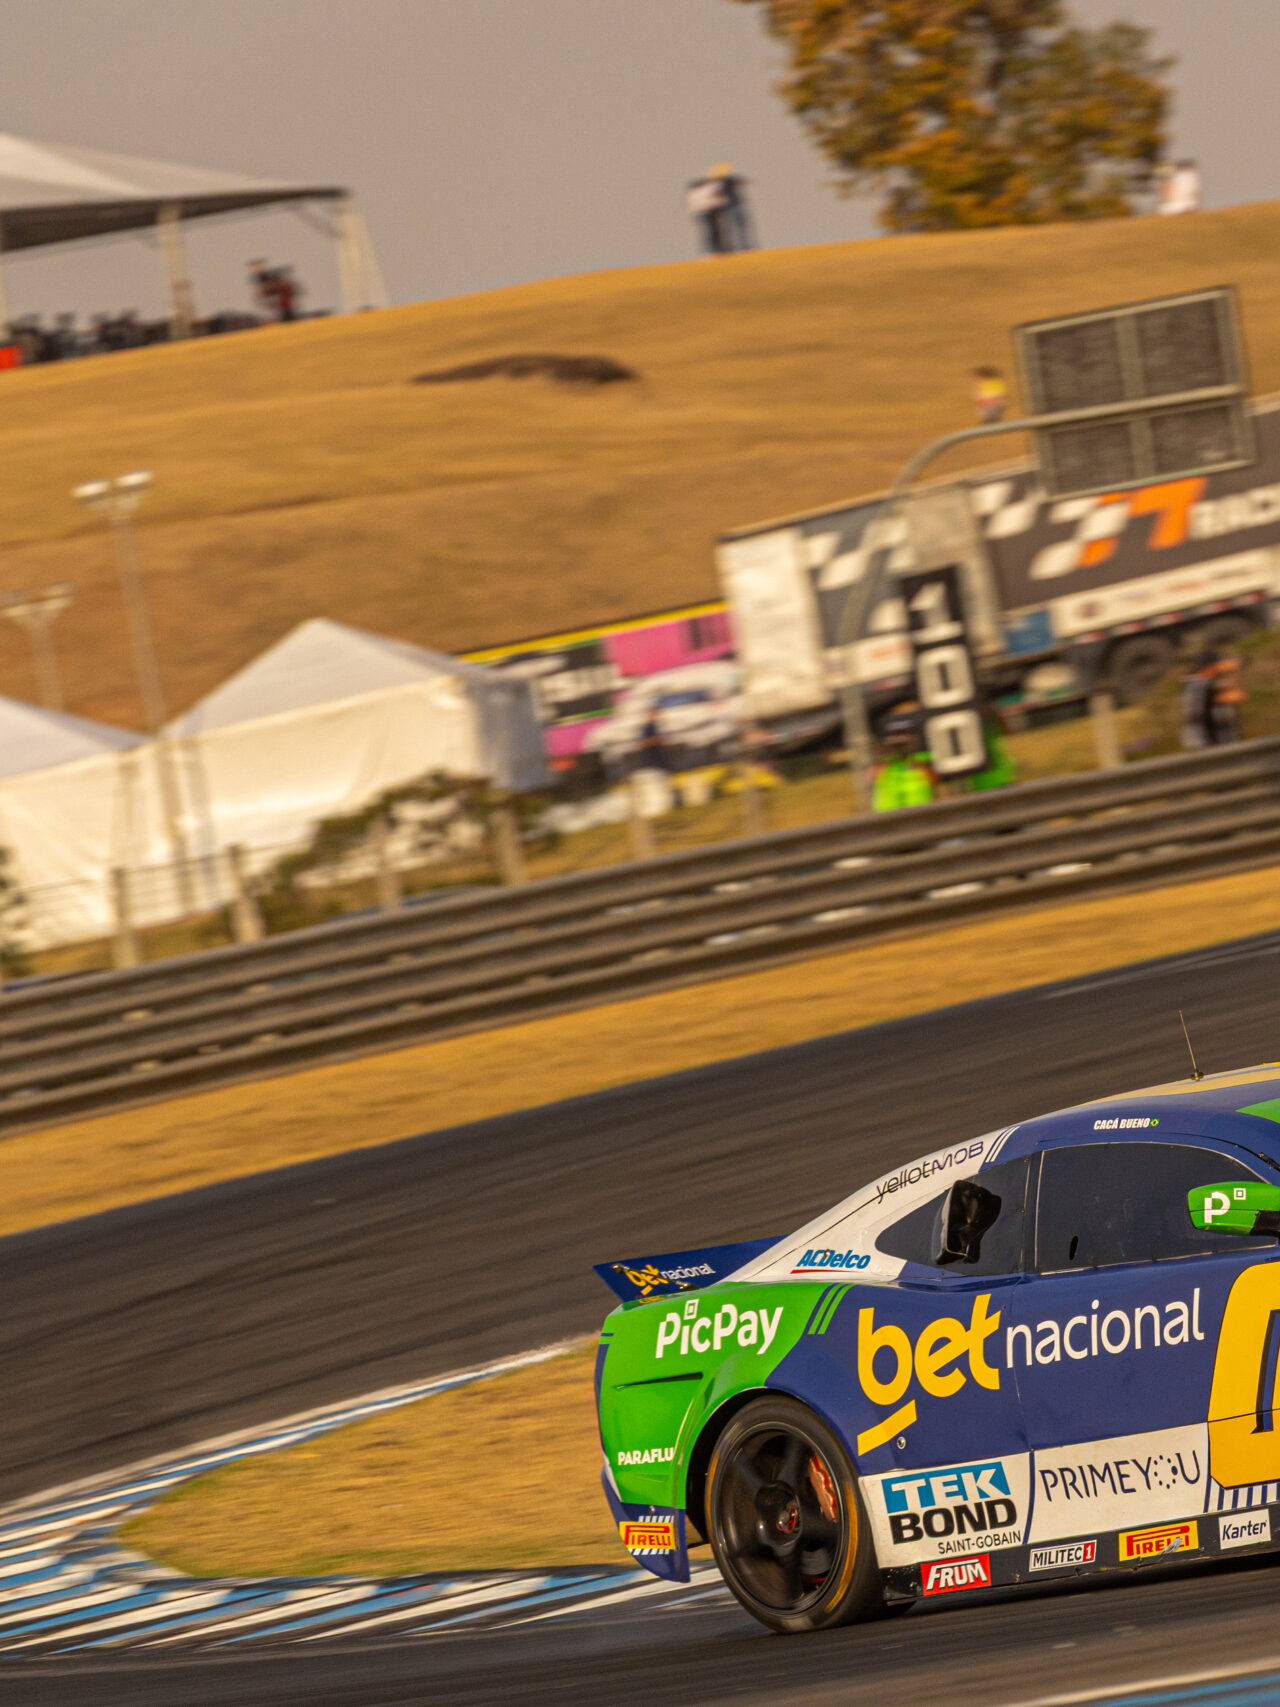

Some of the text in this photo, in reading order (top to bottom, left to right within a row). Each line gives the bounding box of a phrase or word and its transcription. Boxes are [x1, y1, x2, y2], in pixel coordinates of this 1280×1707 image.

[908, 581, 986, 774] 100
[1093, 1117, 1150, 1130] CACÁ BUENO
[796, 1249, 871, 1268] ACDelco
[660, 1263, 716, 1280] nacional
[655, 1299, 784, 1359] PicPay
[857, 1287, 1204, 1406] bet nacional
[618, 1447, 674, 1465] PARAFLU
[891, 1468, 997, 1511] TEK
[888, 1498, 1017, 1544] BOND
[1222, 1519, 1267, 1542] Karter
[624, 1525, 671, 1546] PIRELLI
[938, 1530, 1021, 1554] SAINT-GOBAIN
[926, 1558, 988, 1590] FRUM
